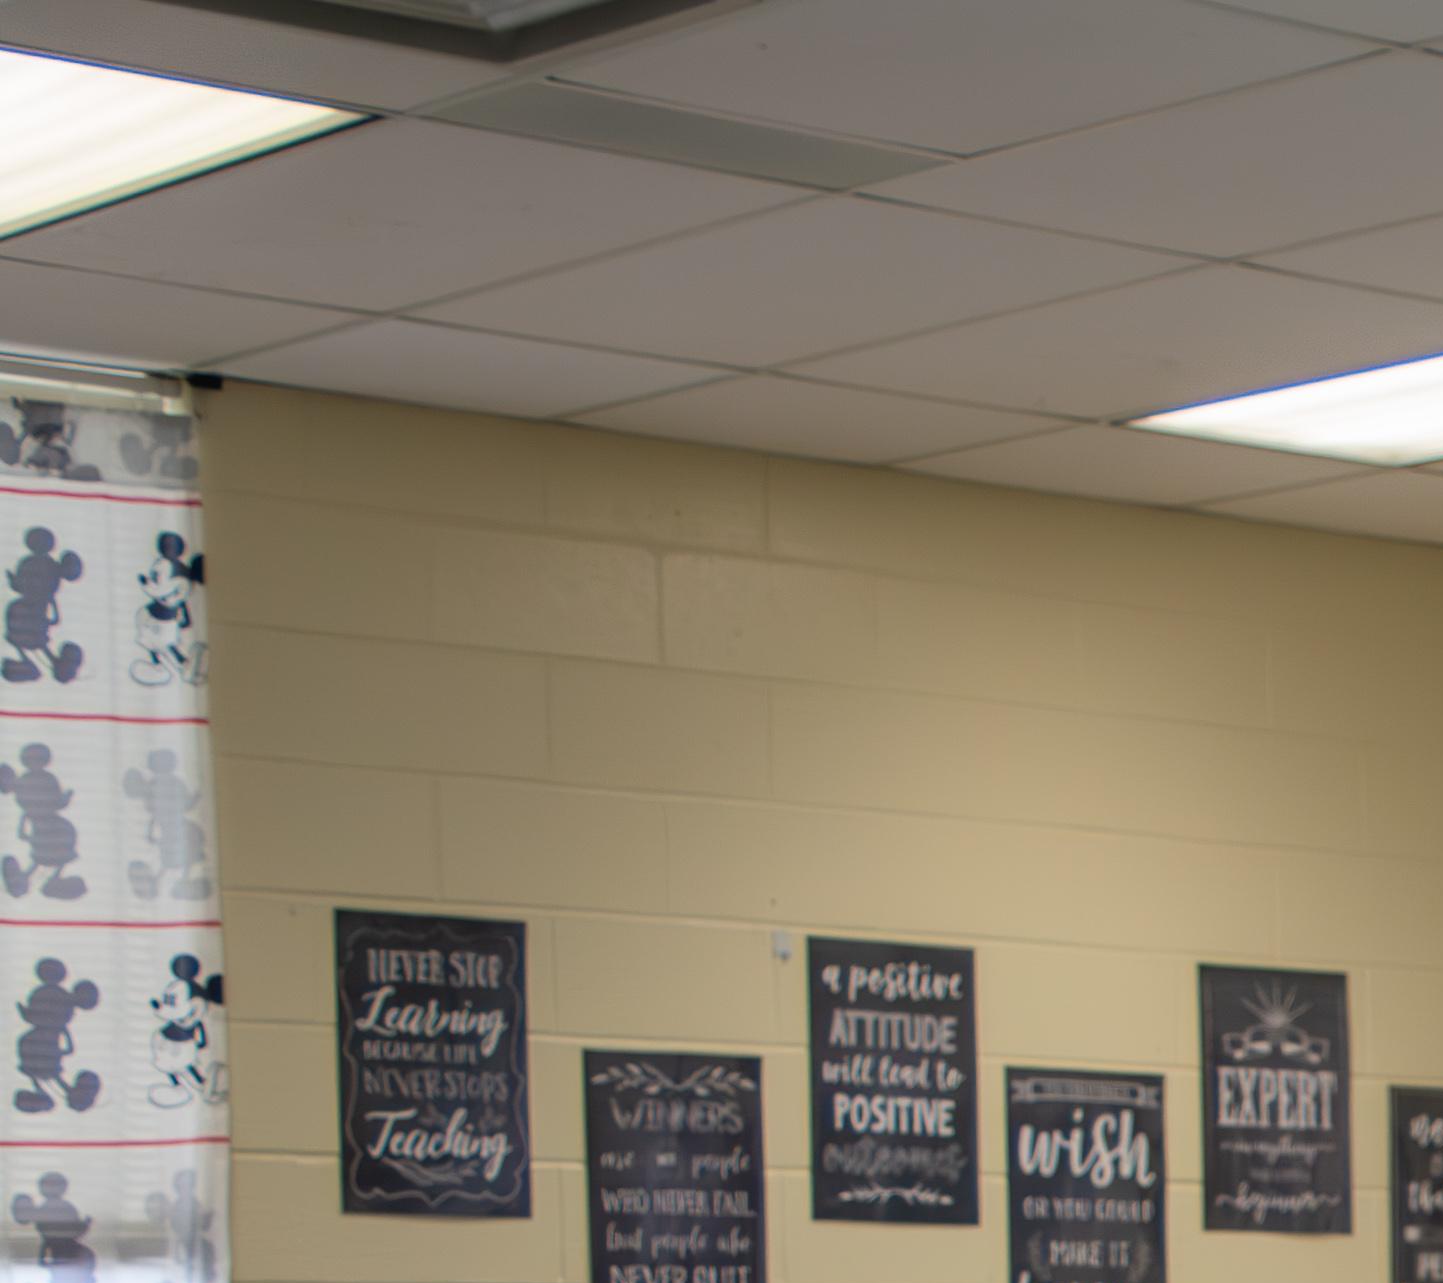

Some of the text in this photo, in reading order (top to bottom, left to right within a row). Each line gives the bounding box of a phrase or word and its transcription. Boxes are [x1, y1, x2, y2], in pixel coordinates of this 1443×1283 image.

[367, 948, 500, 989] NEVER STOP
[822, 961, 963, 1003] a positive
[355, 985, 508, 1058] Learning
[829, 1008, 957, 1053] ATTITUDE
[364, 1068, 508, 1102] NEVER STOPS
[822, 1054, 966, 1092] will lead to
[609, 1097, 743, 1134] WINNERS
[833, 1092, 956, 1136] POSITIVE
[1217, 1066, 1338, 1130] EXPERT
[365, 1107, 513, 1181] Teaching
[1018, 1106, 1157, 1189] wish
[1053, 1197, 1091, 1222] YOU
[1094, 1199, 1155, 1223] COULD
[1050, 1240, 1130, 1268] MAKE IT
